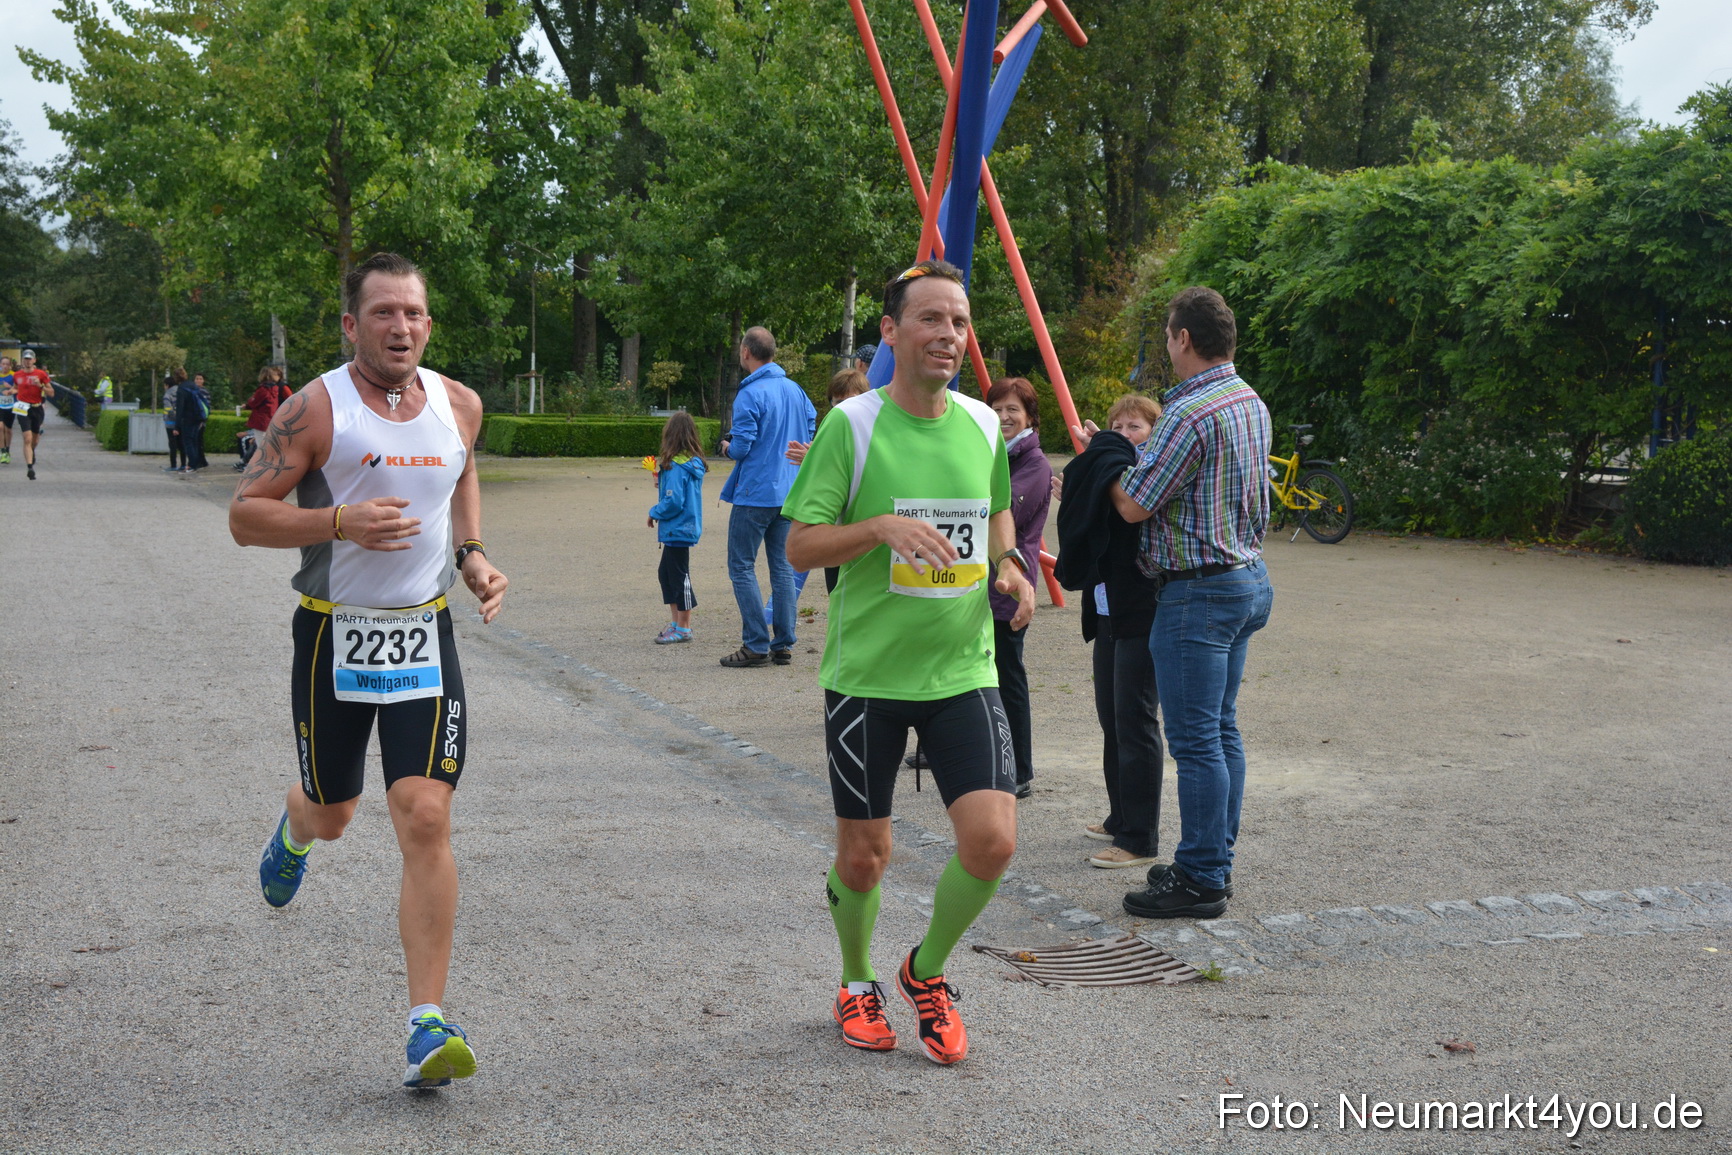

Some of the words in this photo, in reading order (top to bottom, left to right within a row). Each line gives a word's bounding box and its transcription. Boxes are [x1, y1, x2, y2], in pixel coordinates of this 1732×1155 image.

[385, 455, 447, 467] KLEBL
[932, 508, 978, 518] Neumarkt
[931, 569, 956, 584] Udo
[372, 614, 419, 625] Neumarkt
[345, 627, 430, 666] 2232
[356, 674, 419, 692] Wolfgang
[444, 698, 461, 759] SKINS
